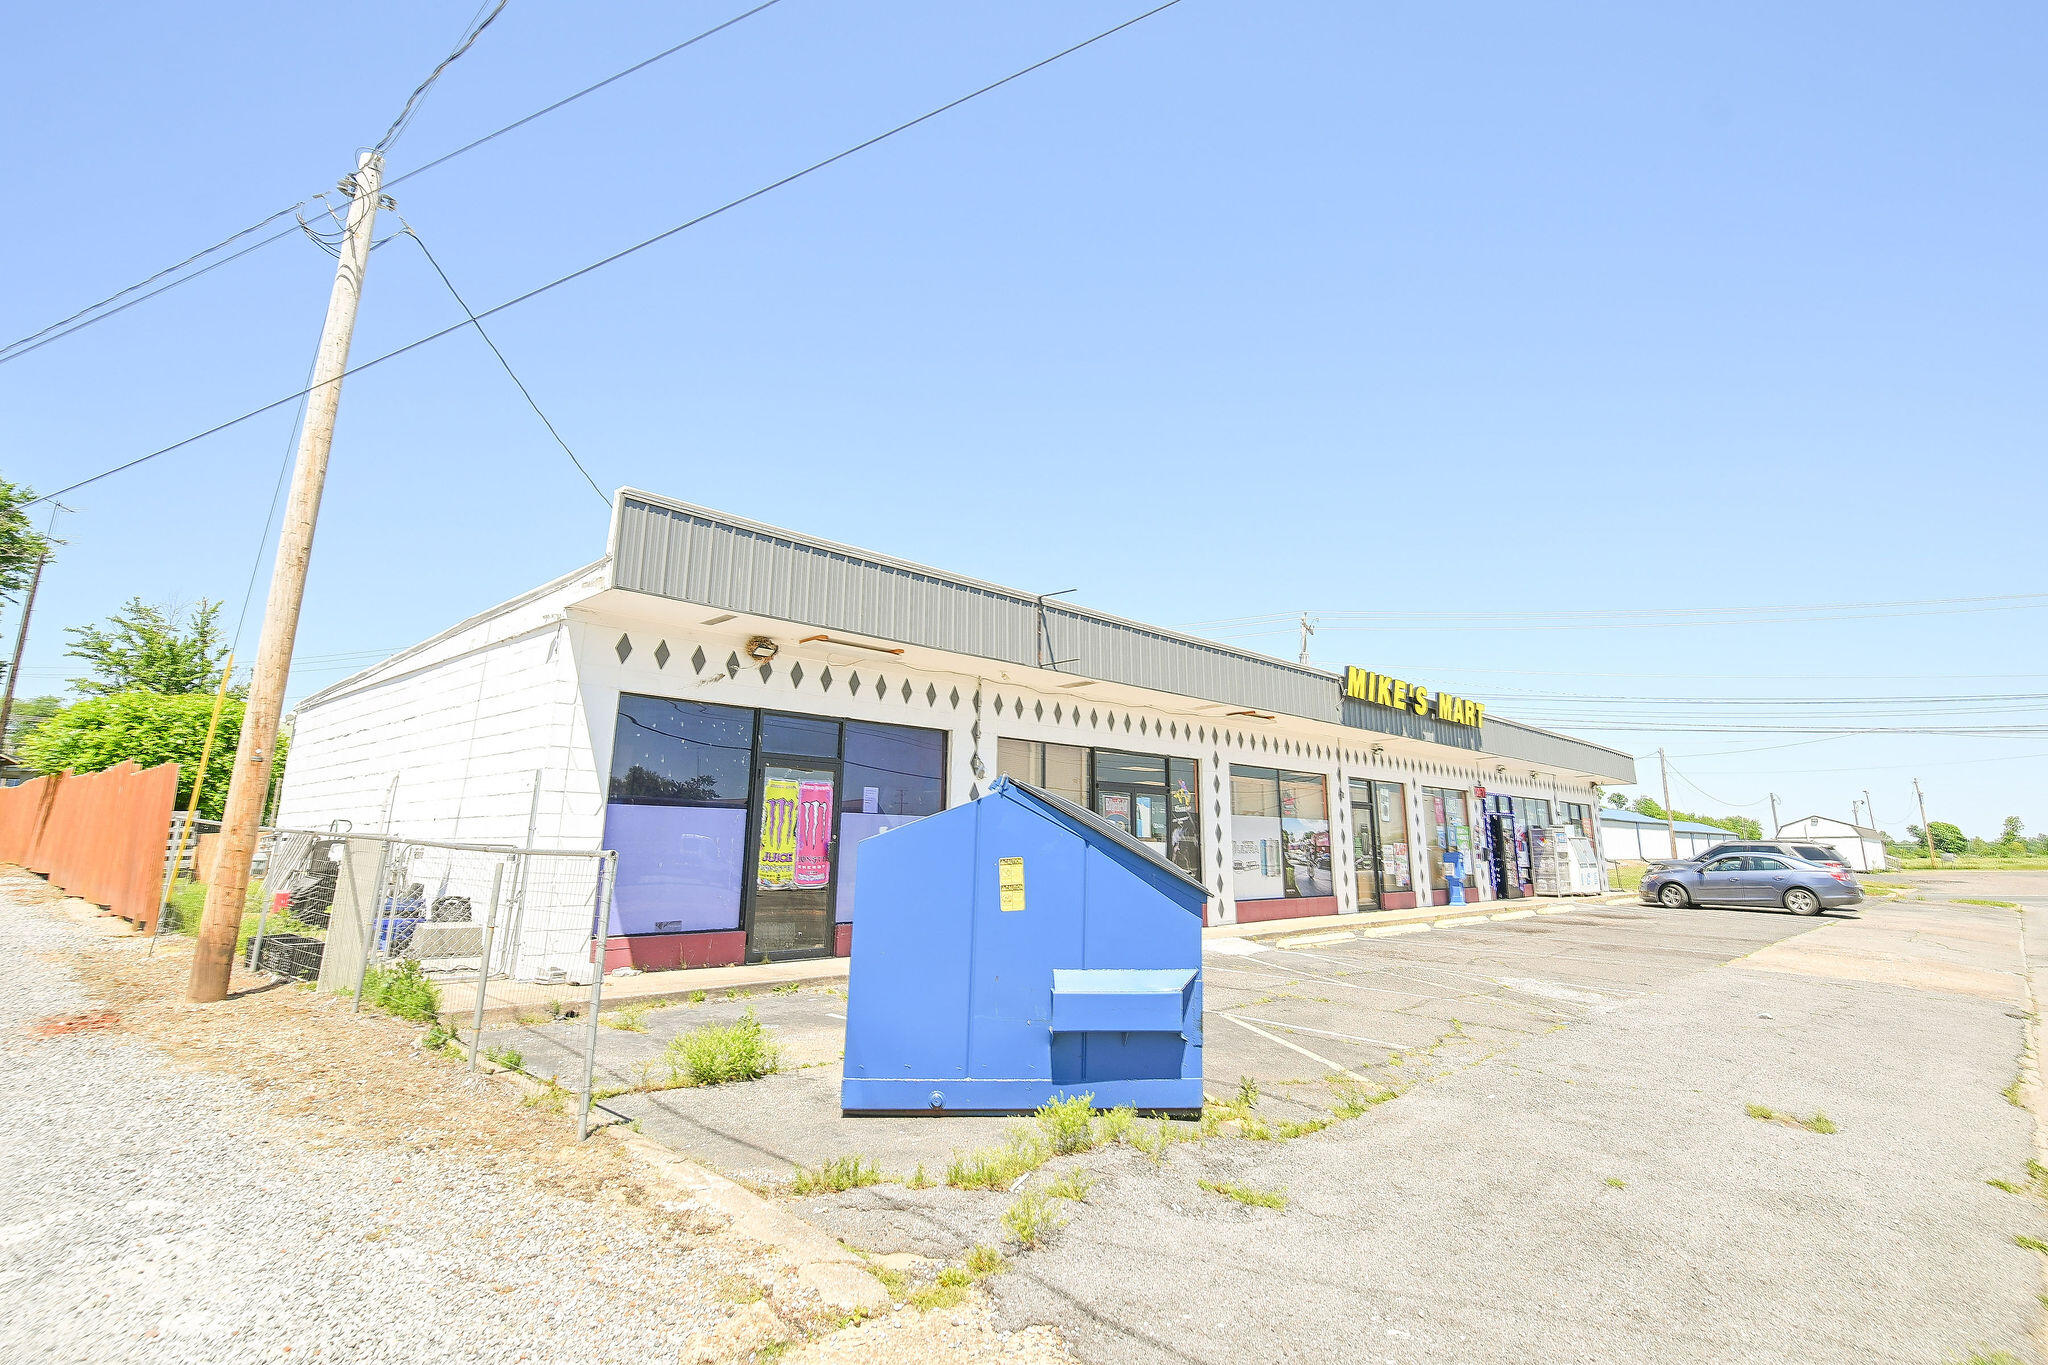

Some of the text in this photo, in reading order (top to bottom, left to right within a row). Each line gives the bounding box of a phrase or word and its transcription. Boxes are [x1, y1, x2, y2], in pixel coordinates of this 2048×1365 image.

[1345, 665, 1486, 729] MIKE'S MART
[761, 852, 793, 862] JUICE
